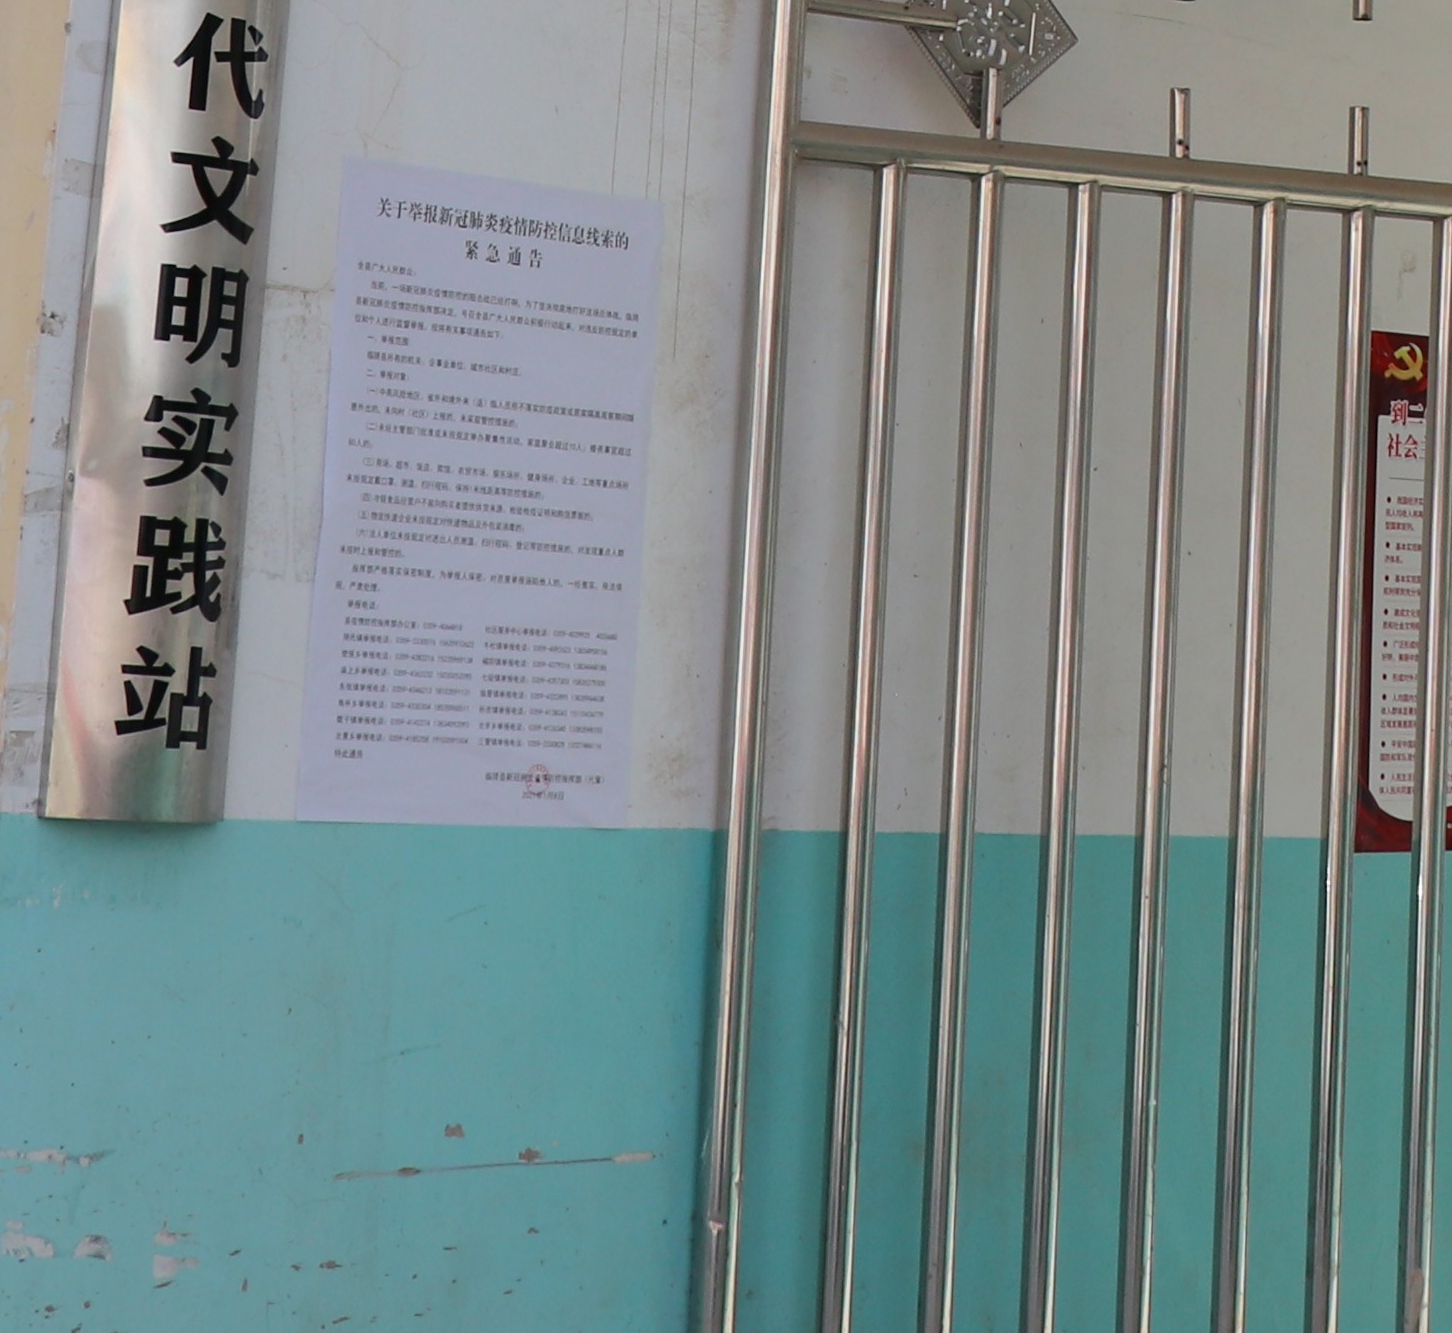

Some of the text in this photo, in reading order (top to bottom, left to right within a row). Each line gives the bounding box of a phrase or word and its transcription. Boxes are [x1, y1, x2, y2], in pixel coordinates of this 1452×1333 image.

[377, 195, 629, 251] 关于举报新冠肺炎疫情防控信息线索的
[464, 239, 544, 269] 紧急通告
